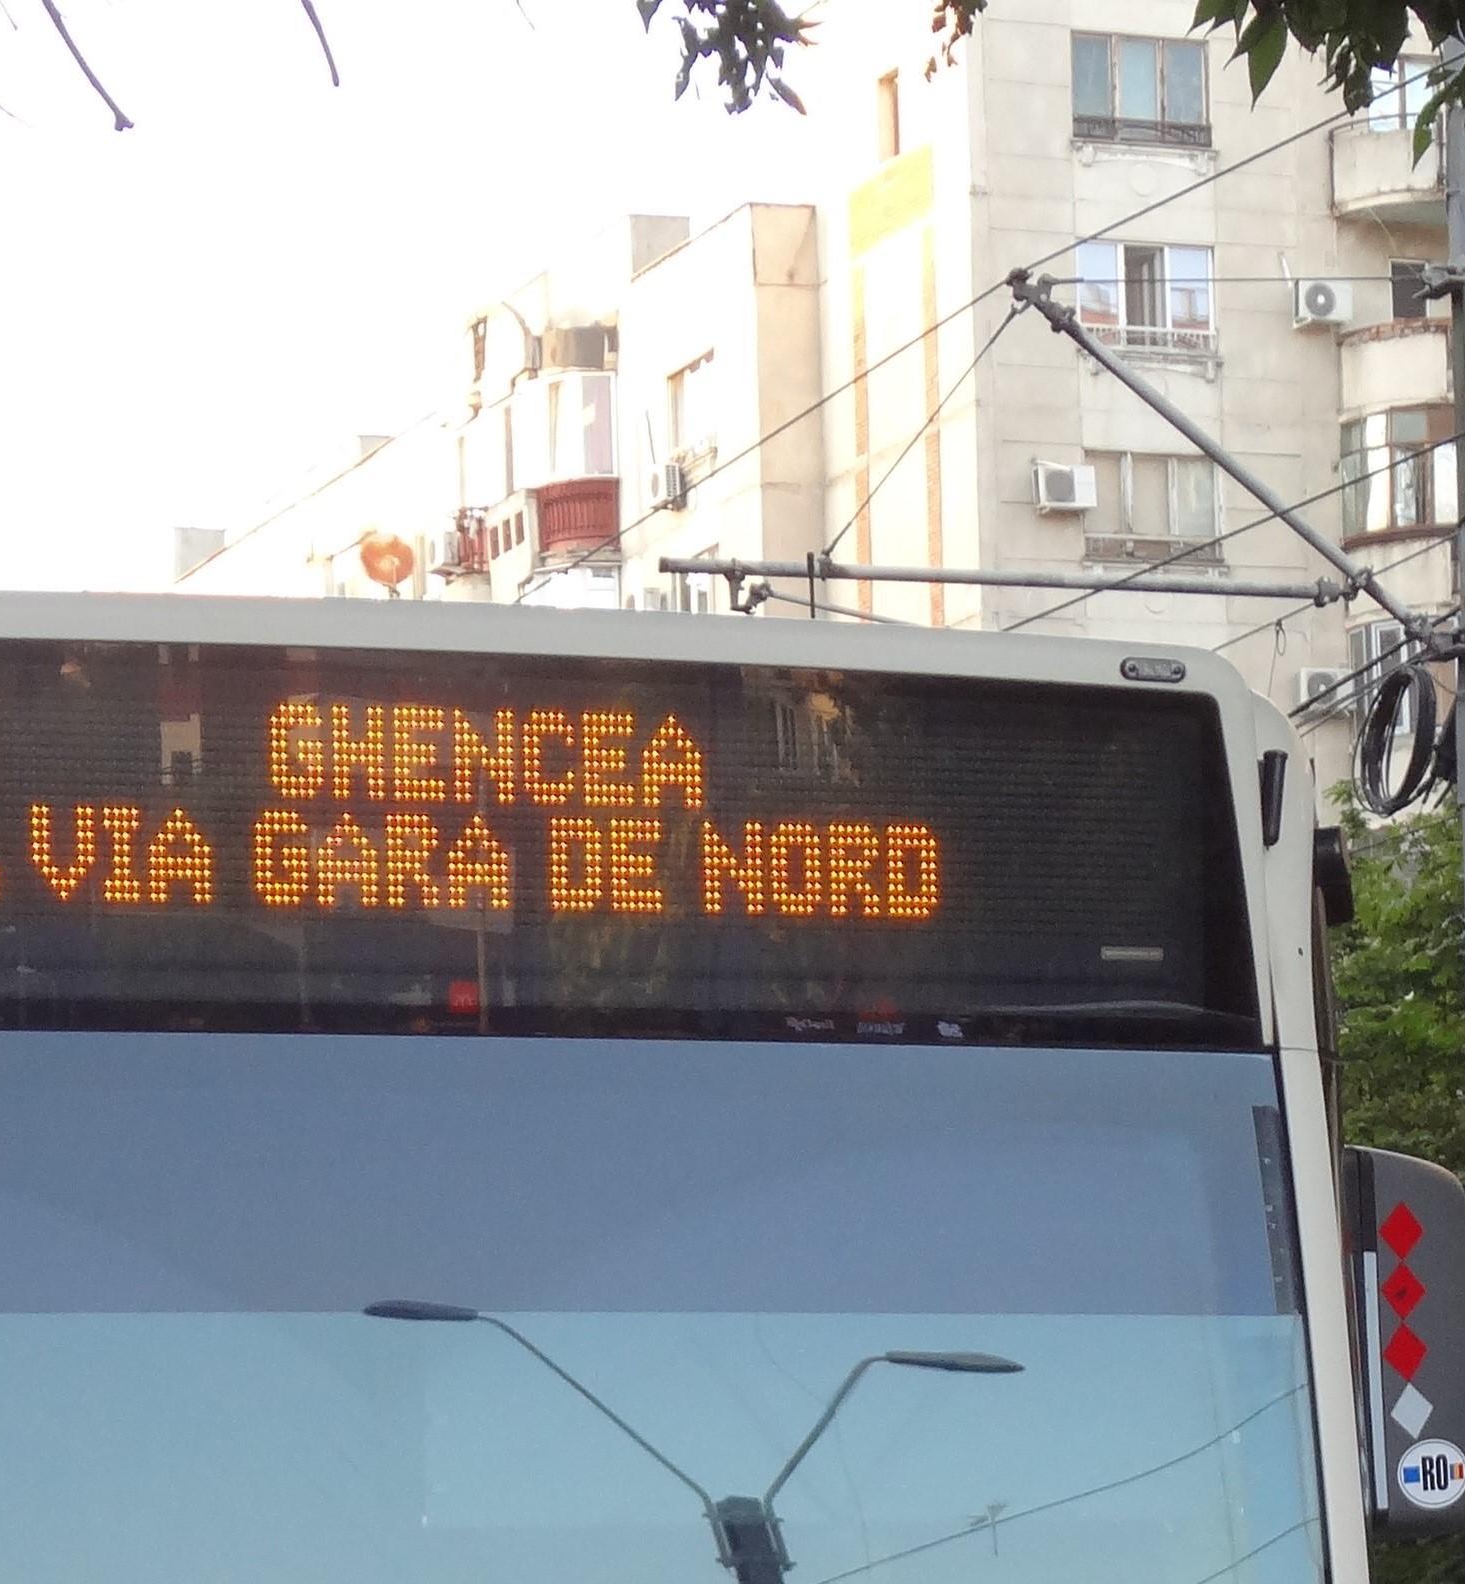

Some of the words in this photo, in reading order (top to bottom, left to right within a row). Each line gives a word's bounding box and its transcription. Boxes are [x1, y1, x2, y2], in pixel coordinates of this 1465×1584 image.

[267, 700, 706, 811] GHENCEA
[29, 803, 215, 905] VIA
[252, 808, 515, 911] GARA
[548, 815, 666, 914] DE
[700, 820, 941, 920] NORD
[1421, 1453, 1449, 1491] RO
